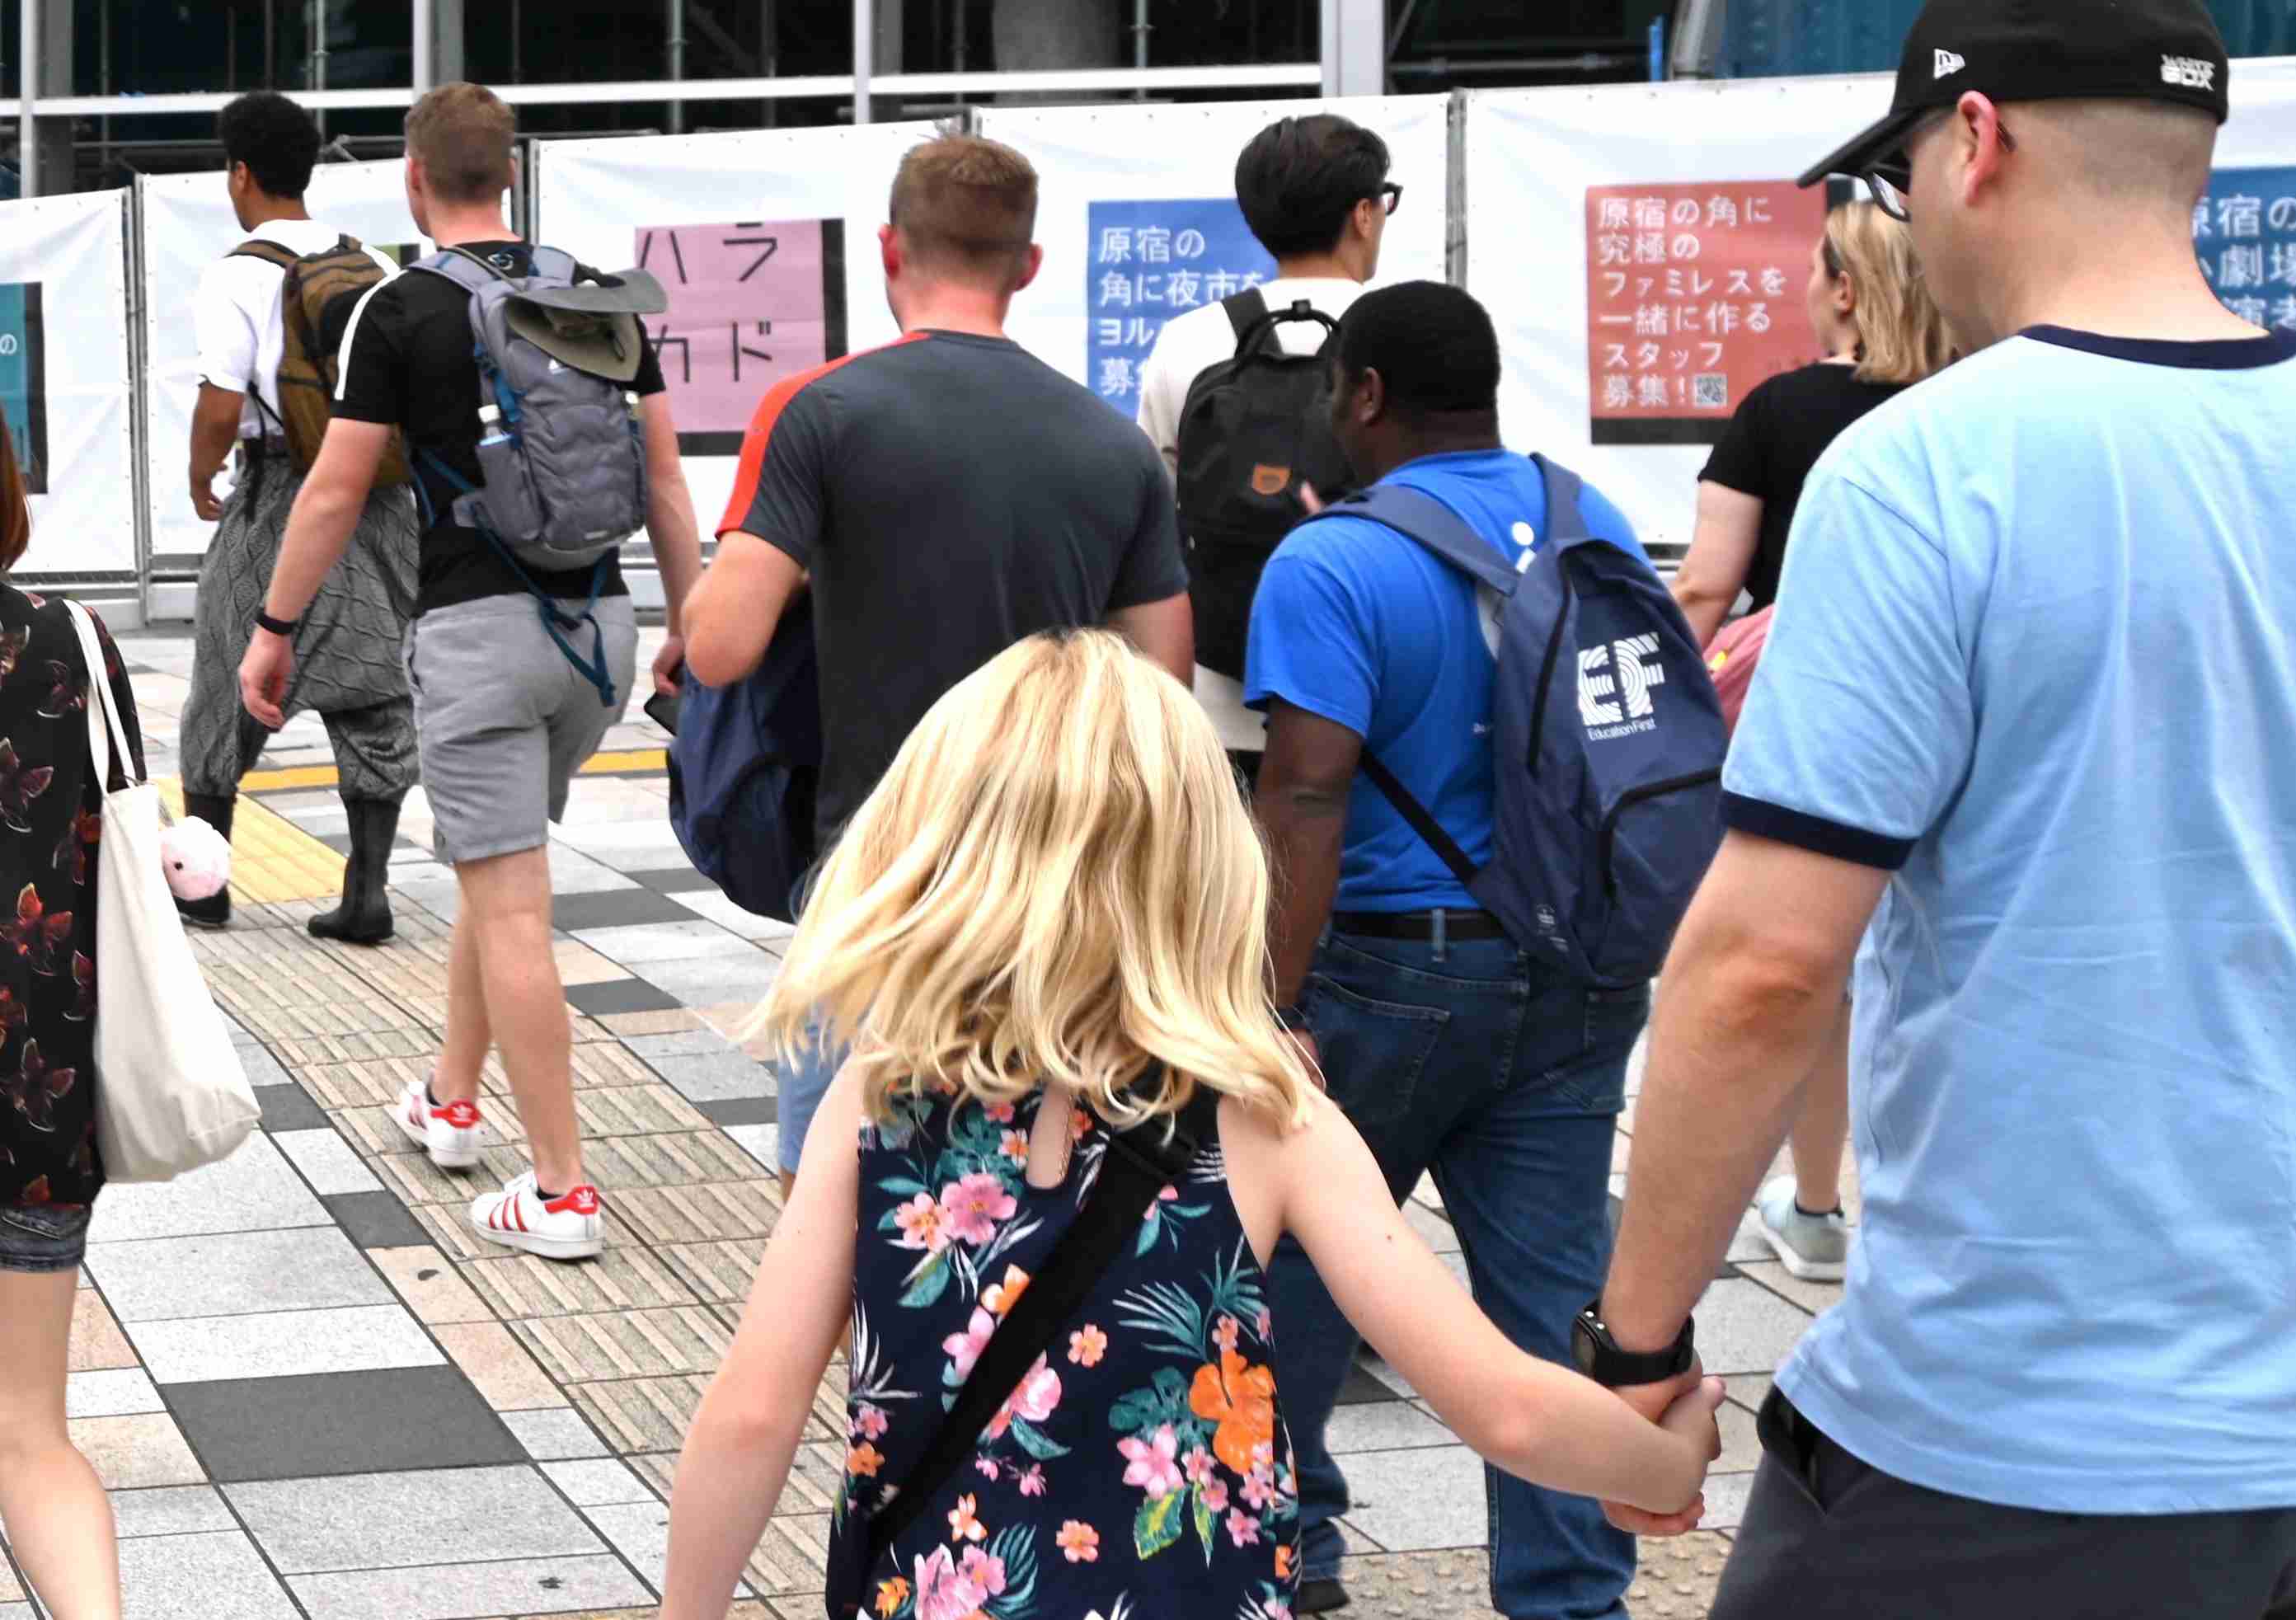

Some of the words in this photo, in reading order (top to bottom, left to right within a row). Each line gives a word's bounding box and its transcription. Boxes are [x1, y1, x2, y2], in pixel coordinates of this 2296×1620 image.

[1599, 195, 1773, 229] 原宿の角に
[1098, 226, 1206, 263] 原宿の
[1599, 233, 1701, 265] 究極の
[1603, 268, 1788, 298] ファミレスを
[1599, 302, 1772, 336] 一緒に作る
[1605, 340, 1724, 369] スタッフ
[1578, 631, 1665, 725] EF
